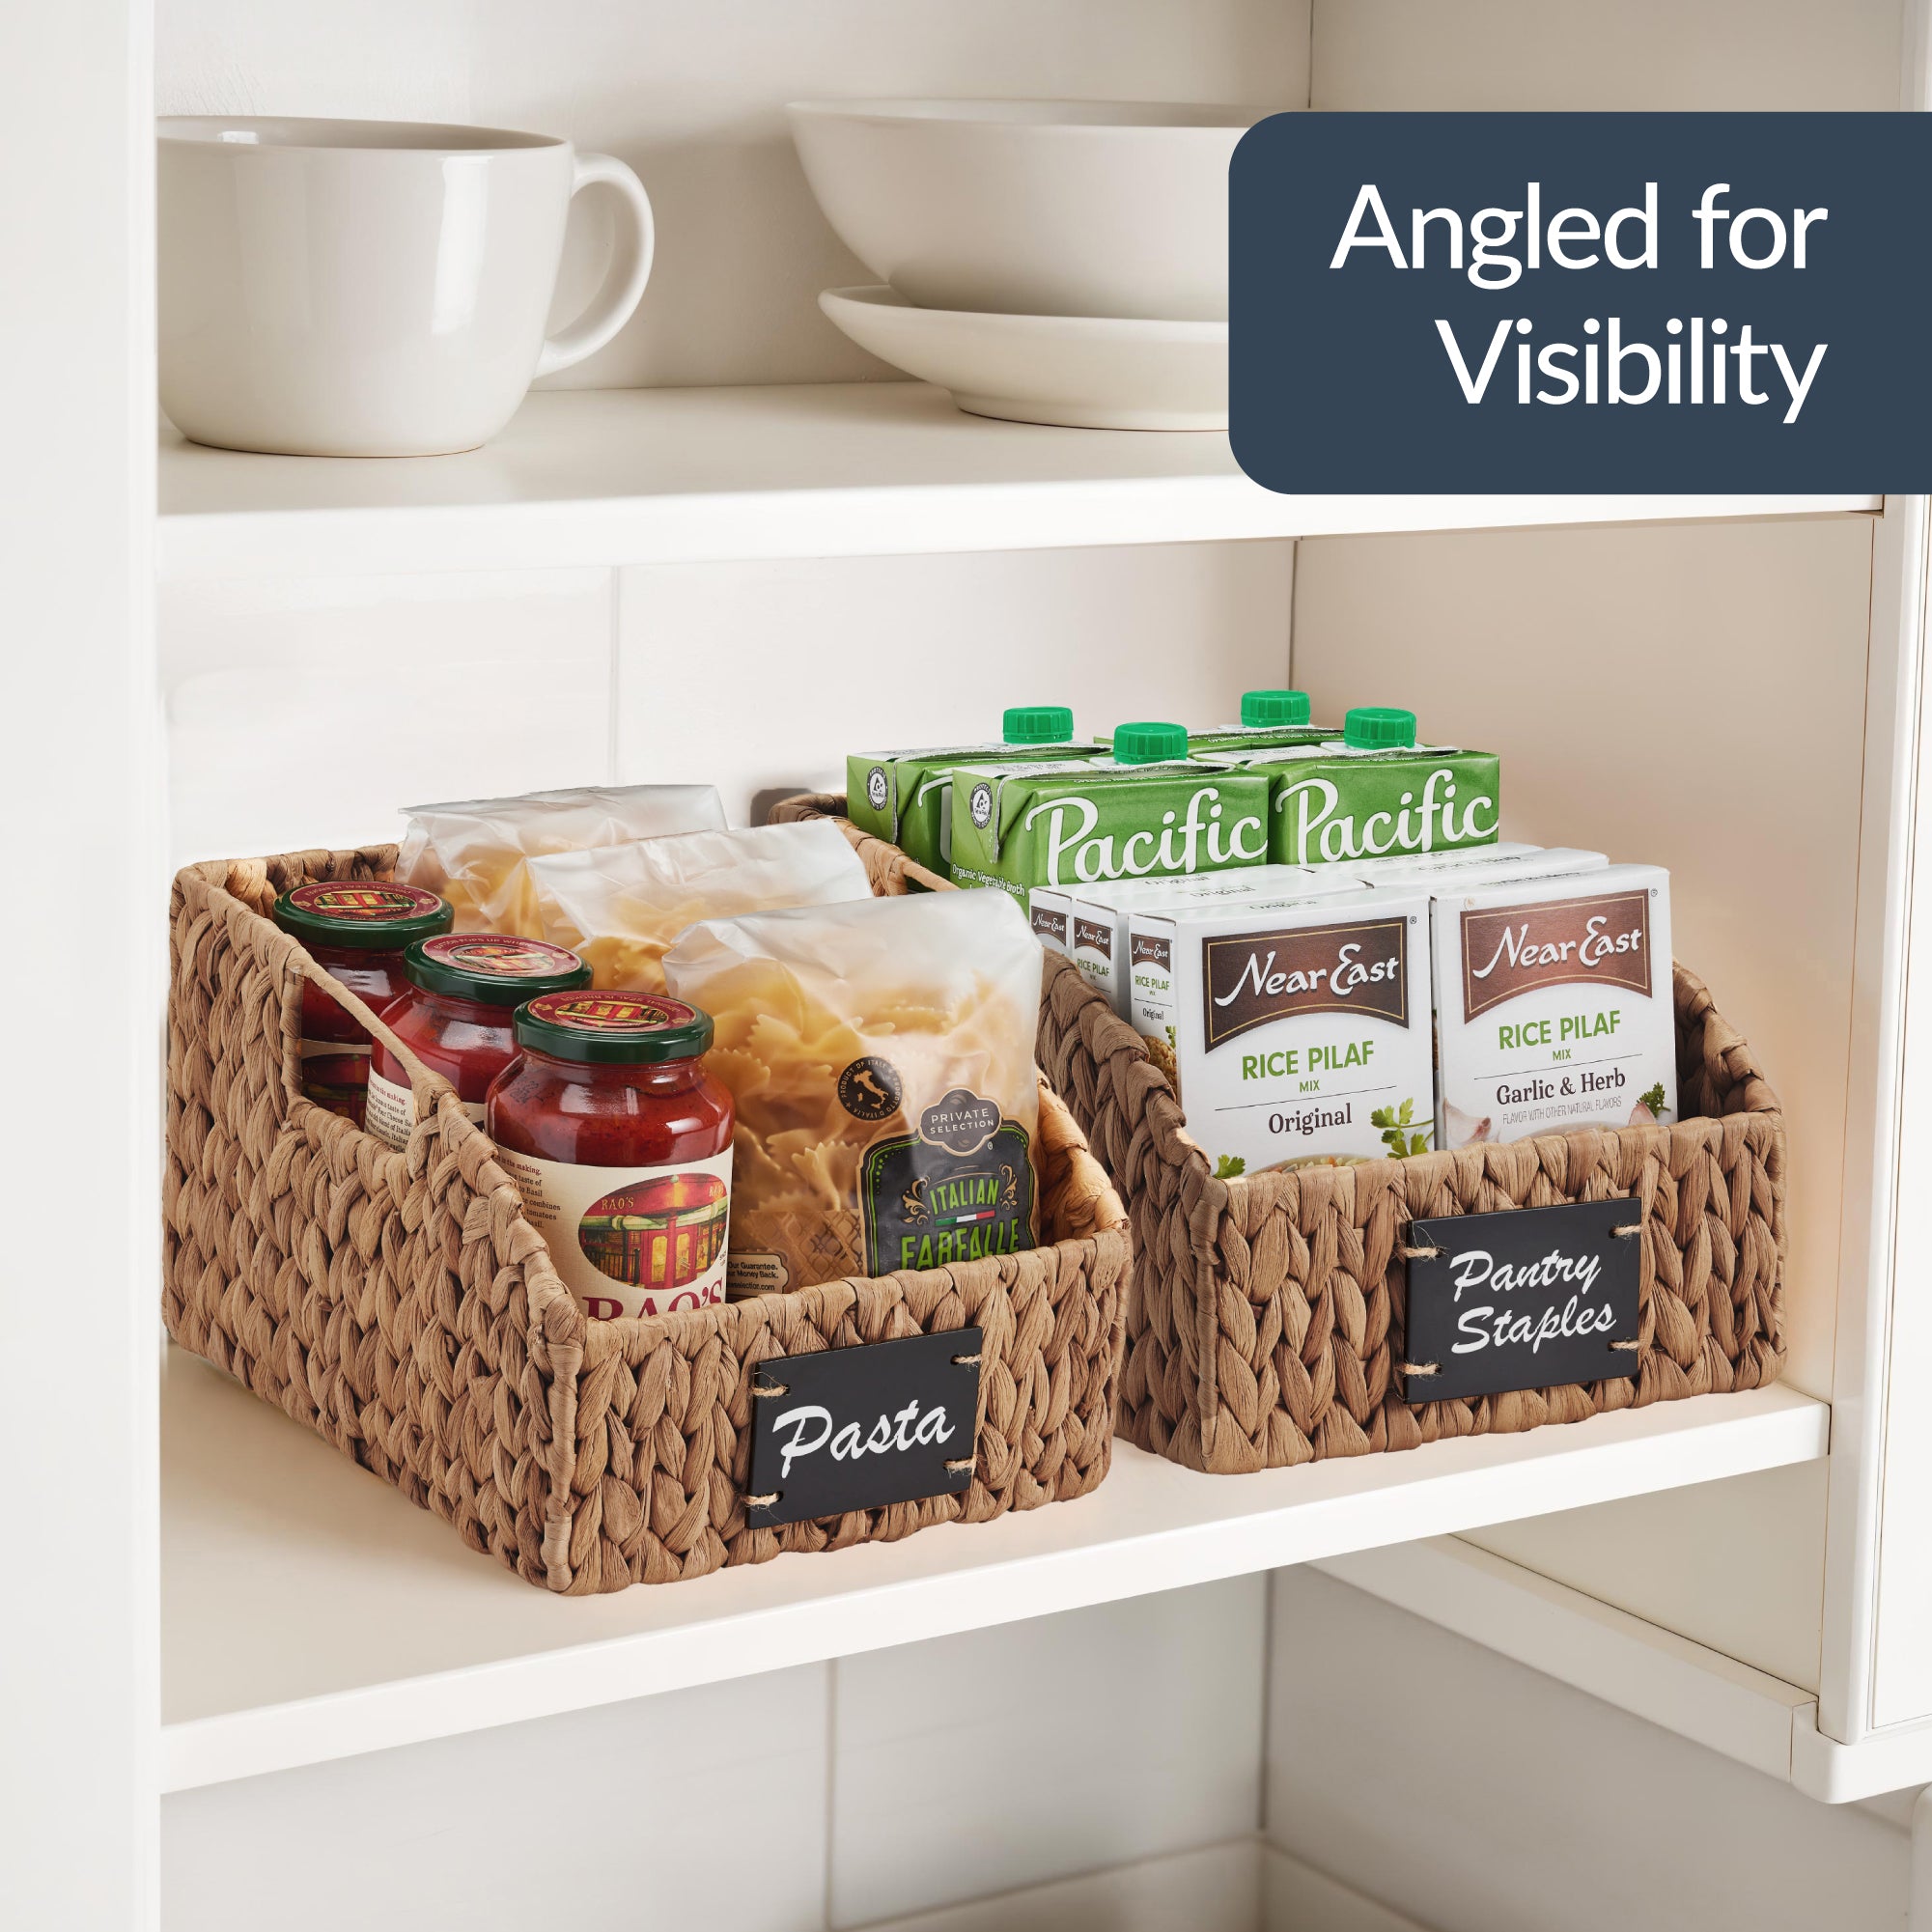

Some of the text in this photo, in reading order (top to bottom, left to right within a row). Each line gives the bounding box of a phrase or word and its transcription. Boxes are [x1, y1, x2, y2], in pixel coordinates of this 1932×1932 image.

[1275, 770, 1499, 865] Pacific
[1024, 787, 1268, 884] Pacific
[952, 863, 1026, 897] Organic Vegetable Broth
[1032, 913, 1065, 932] Near East
[1077, 926, 1109, 945] Near East
[1133, 940, 1168, 960] Near East
[1472, 915, 1642, 978] Near East
[1077, 958, 1109, 977] RICE PILAF
[1215, 943, 1399, 1008] Near East
[1134, 975, 1170, 991] RICE PILAF
[1142, 1007, 1164, 1021] Original
[1499, 1010, 1621, 1050] RICE PILAF
[1242, 1040, 1375, 1082] RICE PILAF
[1553, 1049, 1572, 1062] MIX
[1299, 1079, 1321, 1093] MIX
[1497, 1068, 1626, 1106] Garlic & Herb
[930, 1107, 990, 1124] PRIVATE
[1269, 1103, 1353, 1137] Original
[1502, 1096, 1622, 1125] FLAVOR WITH OTHER NATURAL FLAVORS
[930, 1119, 994, 1134] SELECTION
[517, 1163, 541, 1175] making.
[518, 1174, 533, 1185] taste
[526, 1187, 543, 1197] Basil
[930, 1178, 998, 1214] ITALIAN
[530, 1199, 561, 1211] combines
[602, 1196, 634, 1211] RAO'S
[526, 1209, 557, 1220] tomatoes
[901, 1218, 1019, 1271] FARFALLE
[737, 1270, 759, 1279] Money
[759, 1271, 779, 1279] Back.
[741, 1261, 778, 1271] Guarantee.
[1449, 1249, 1602, 1302] Pantry
[1451, 1295, 1616, 1354] Staples
[772, 1399, 956, 1479] Pasta
